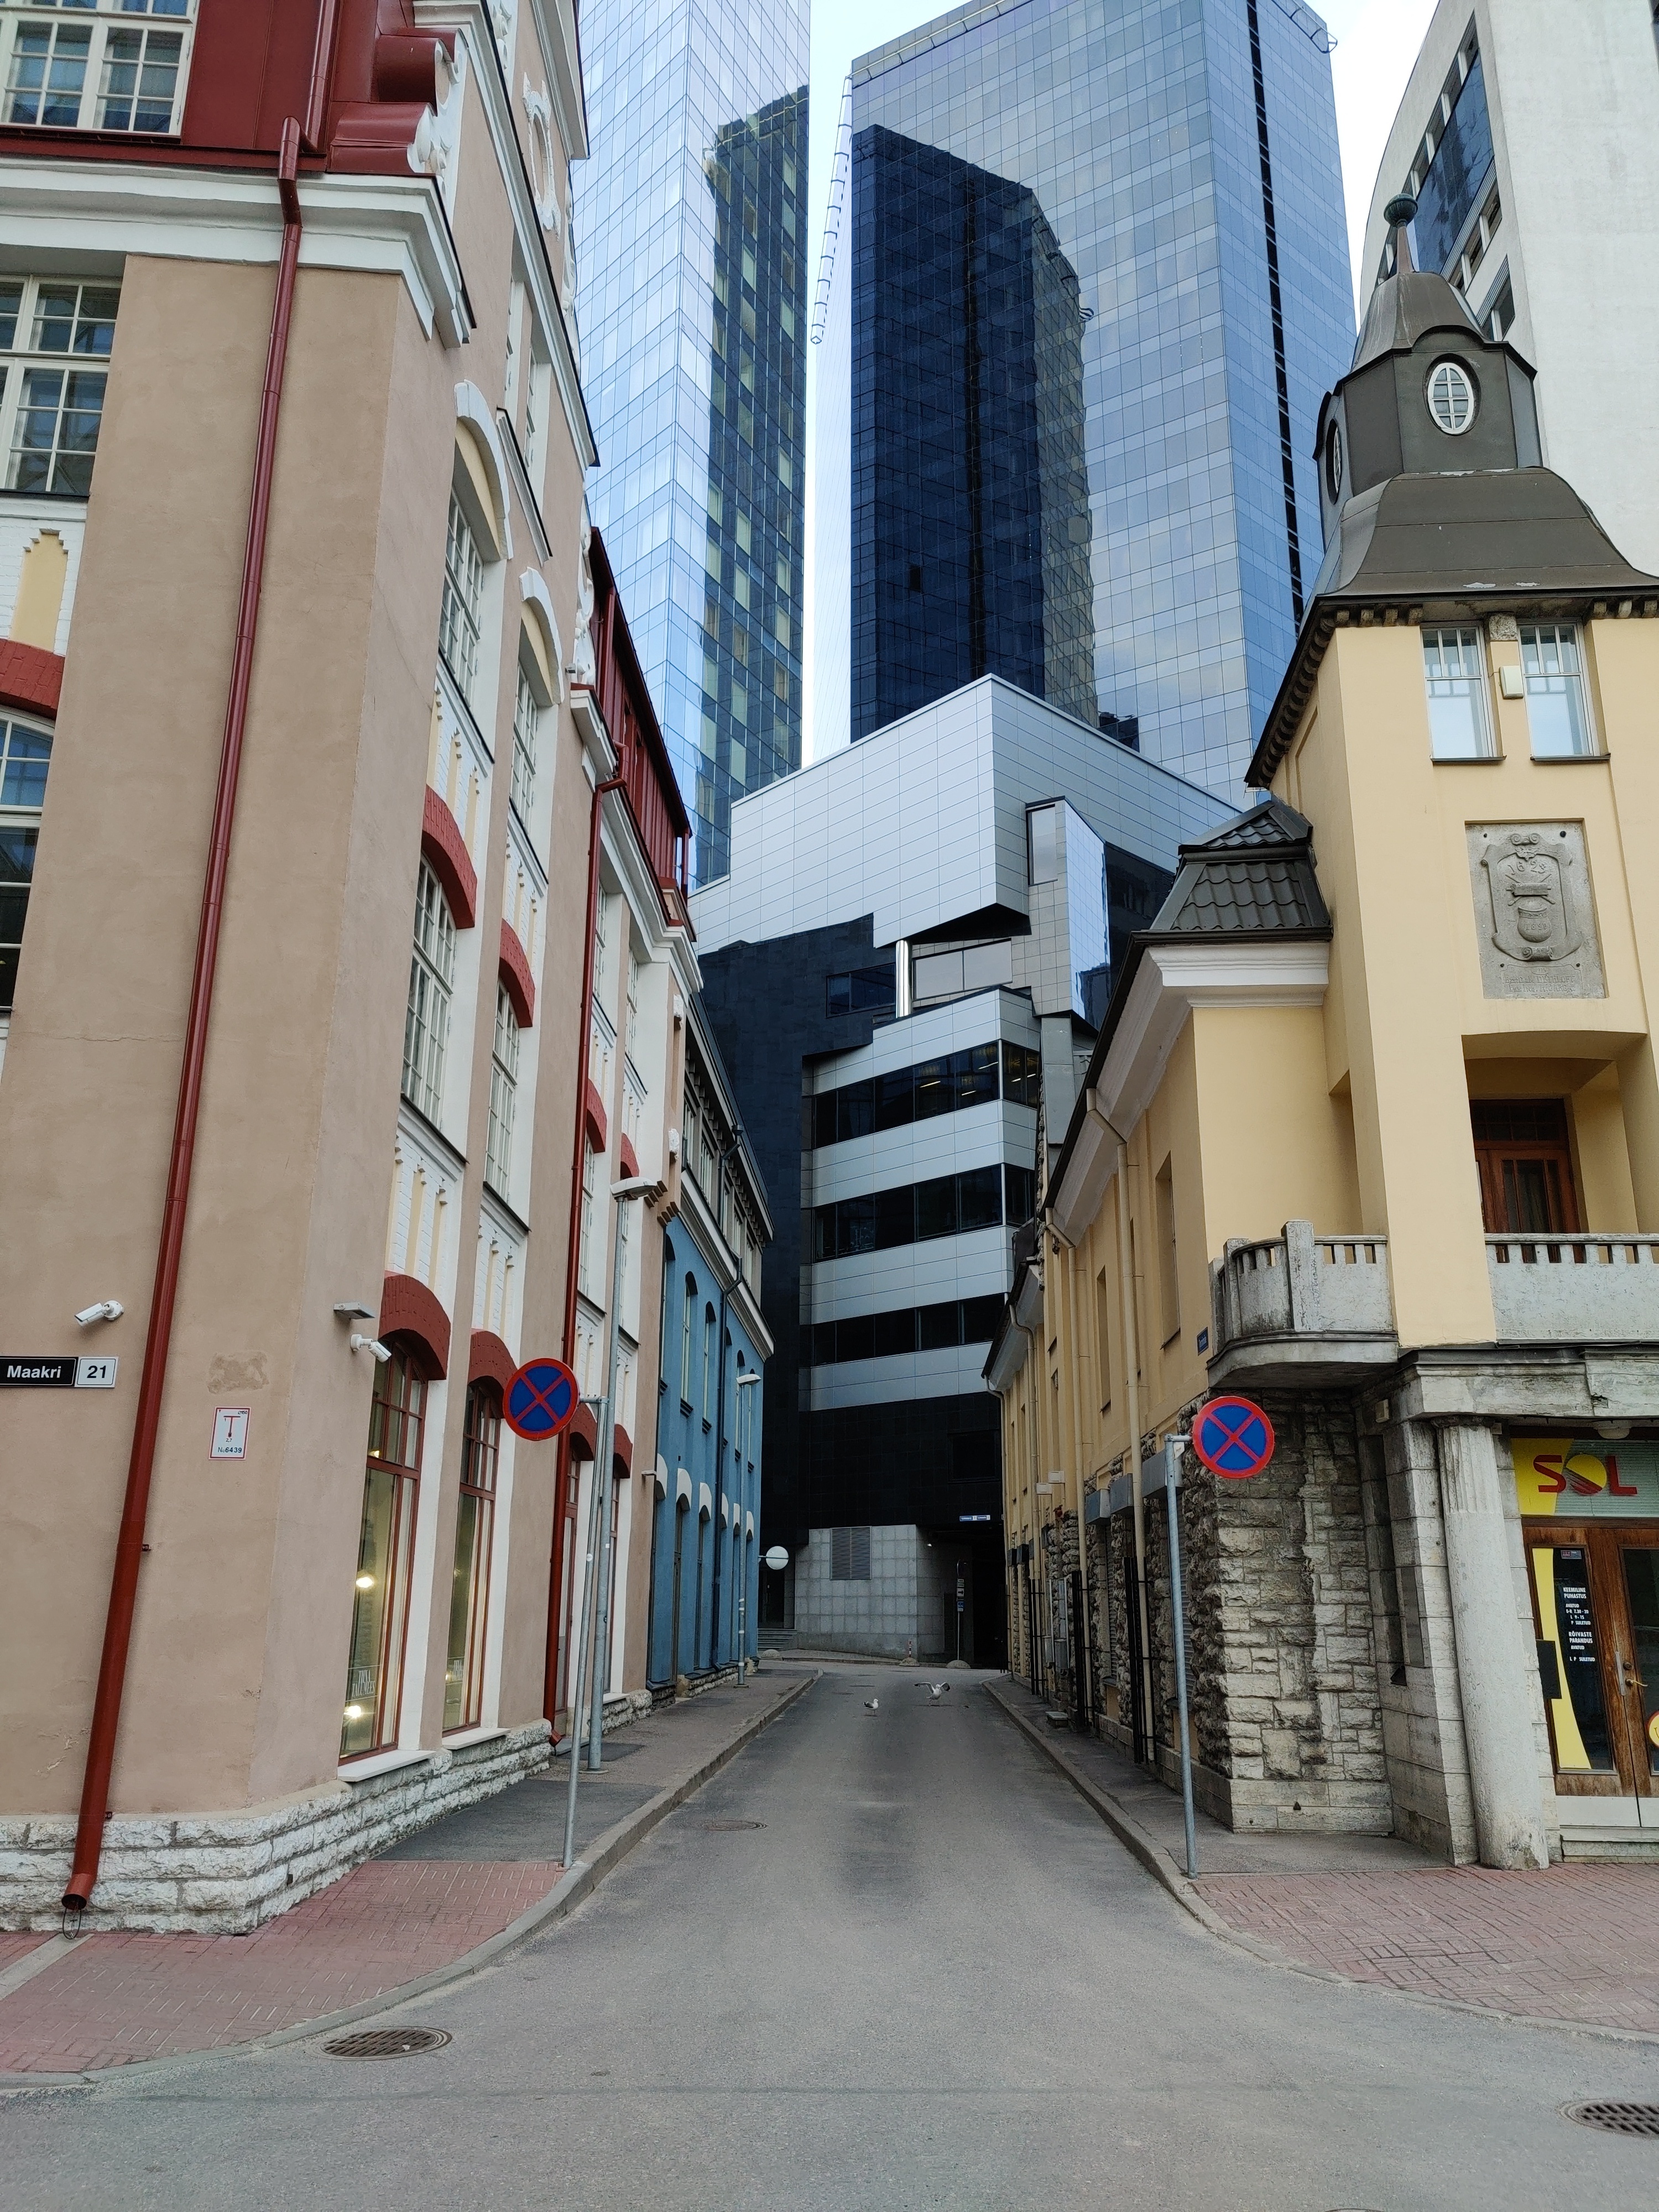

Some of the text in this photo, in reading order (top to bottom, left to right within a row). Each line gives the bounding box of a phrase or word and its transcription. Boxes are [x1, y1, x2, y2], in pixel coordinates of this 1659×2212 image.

[7, 1365, 61, 1378] Maakri
[86, 1365, 107, 1379] 21
[1533, 1454, 1638, 1495] SOL
